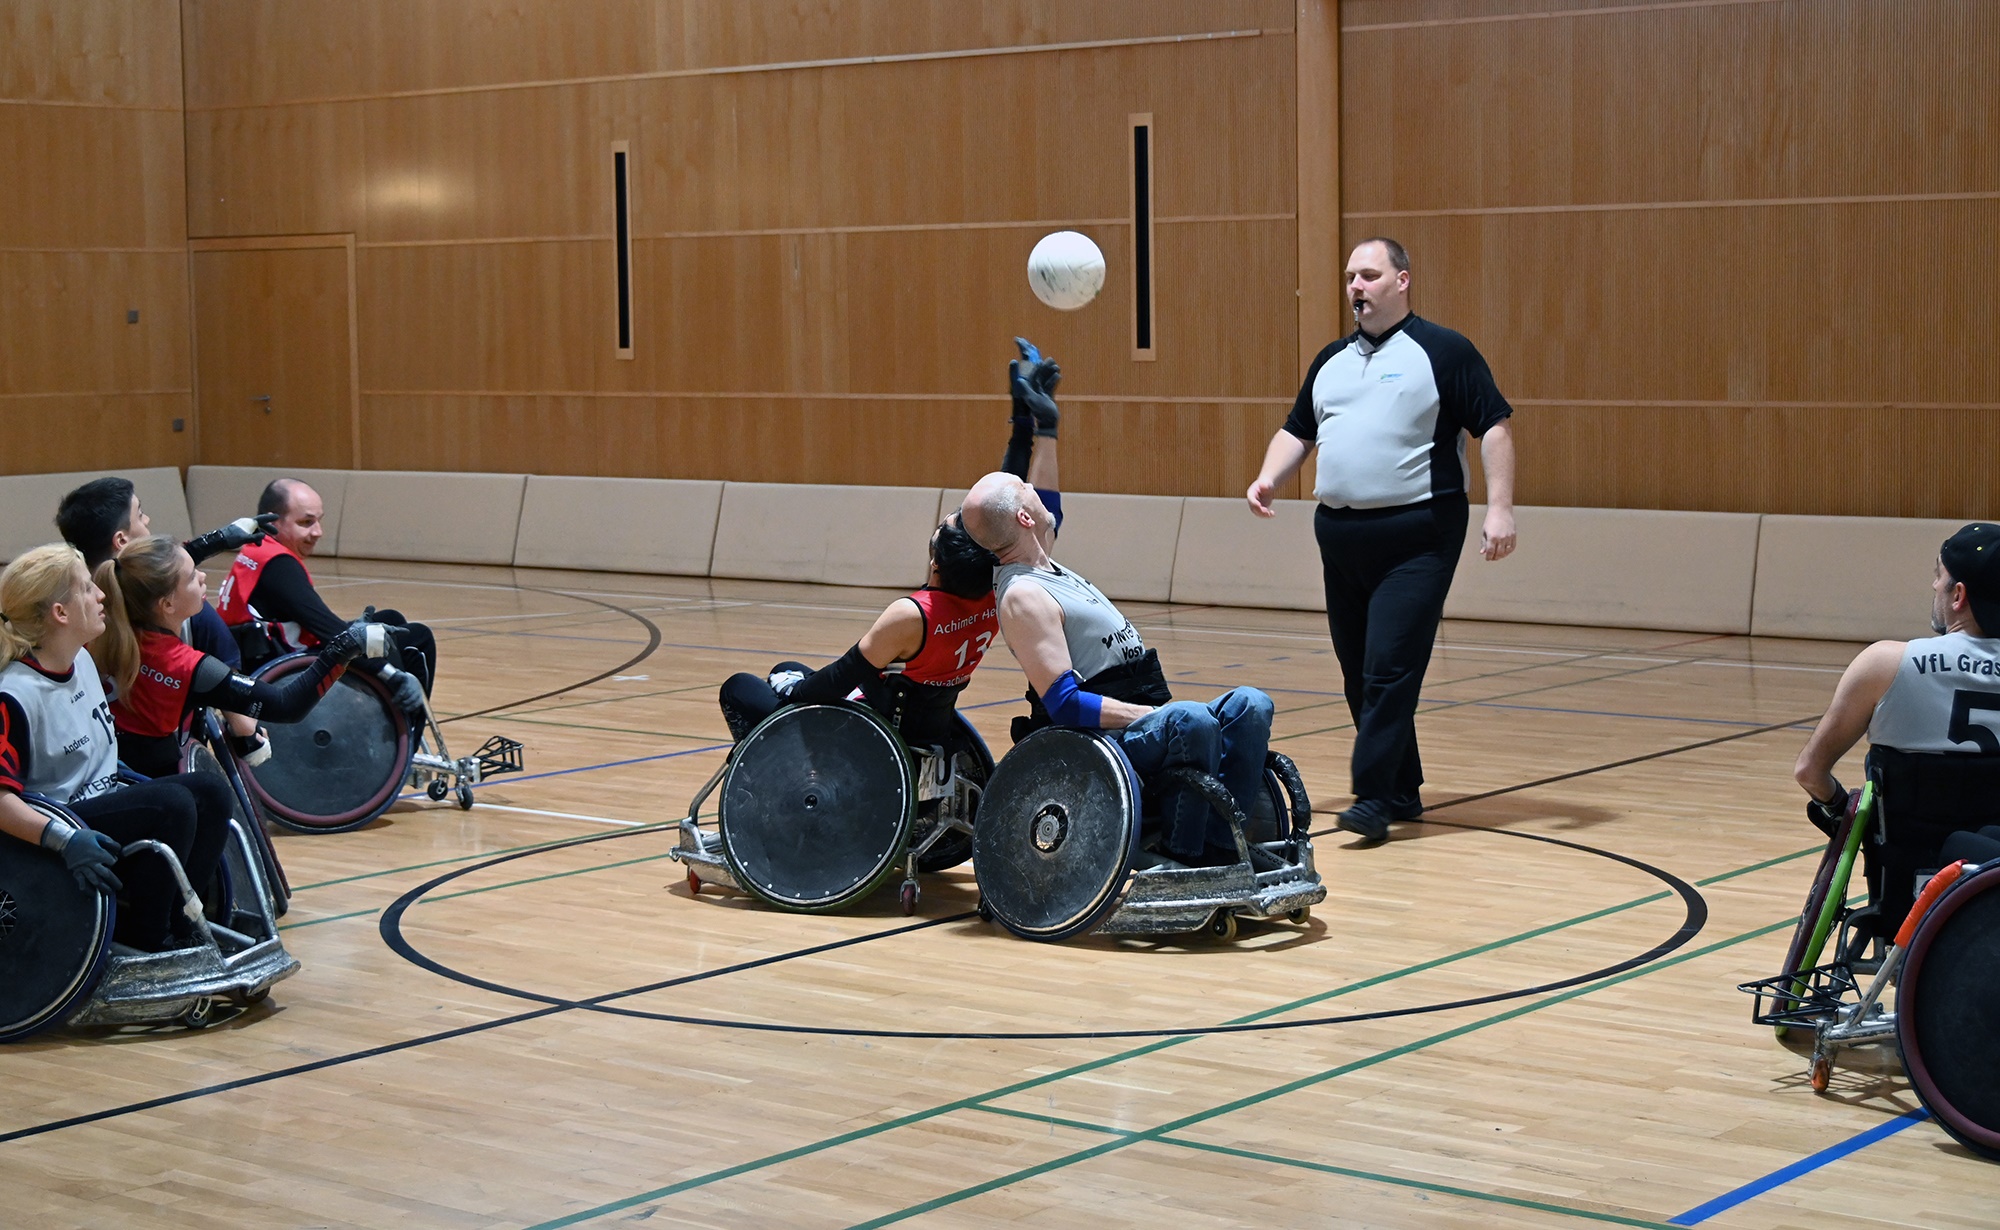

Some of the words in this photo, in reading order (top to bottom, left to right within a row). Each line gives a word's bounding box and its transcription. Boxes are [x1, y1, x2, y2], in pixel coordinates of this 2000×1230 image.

[933, 613, 979, 635] Achimer
[954, 630, 992, 670] 13
[140, 664, 181, 690] eroes
[1912, 653, 1951, 675] VfL
[1957, 653, 2000, 677] Gras
[1947, 689, 2000, 753] 5
